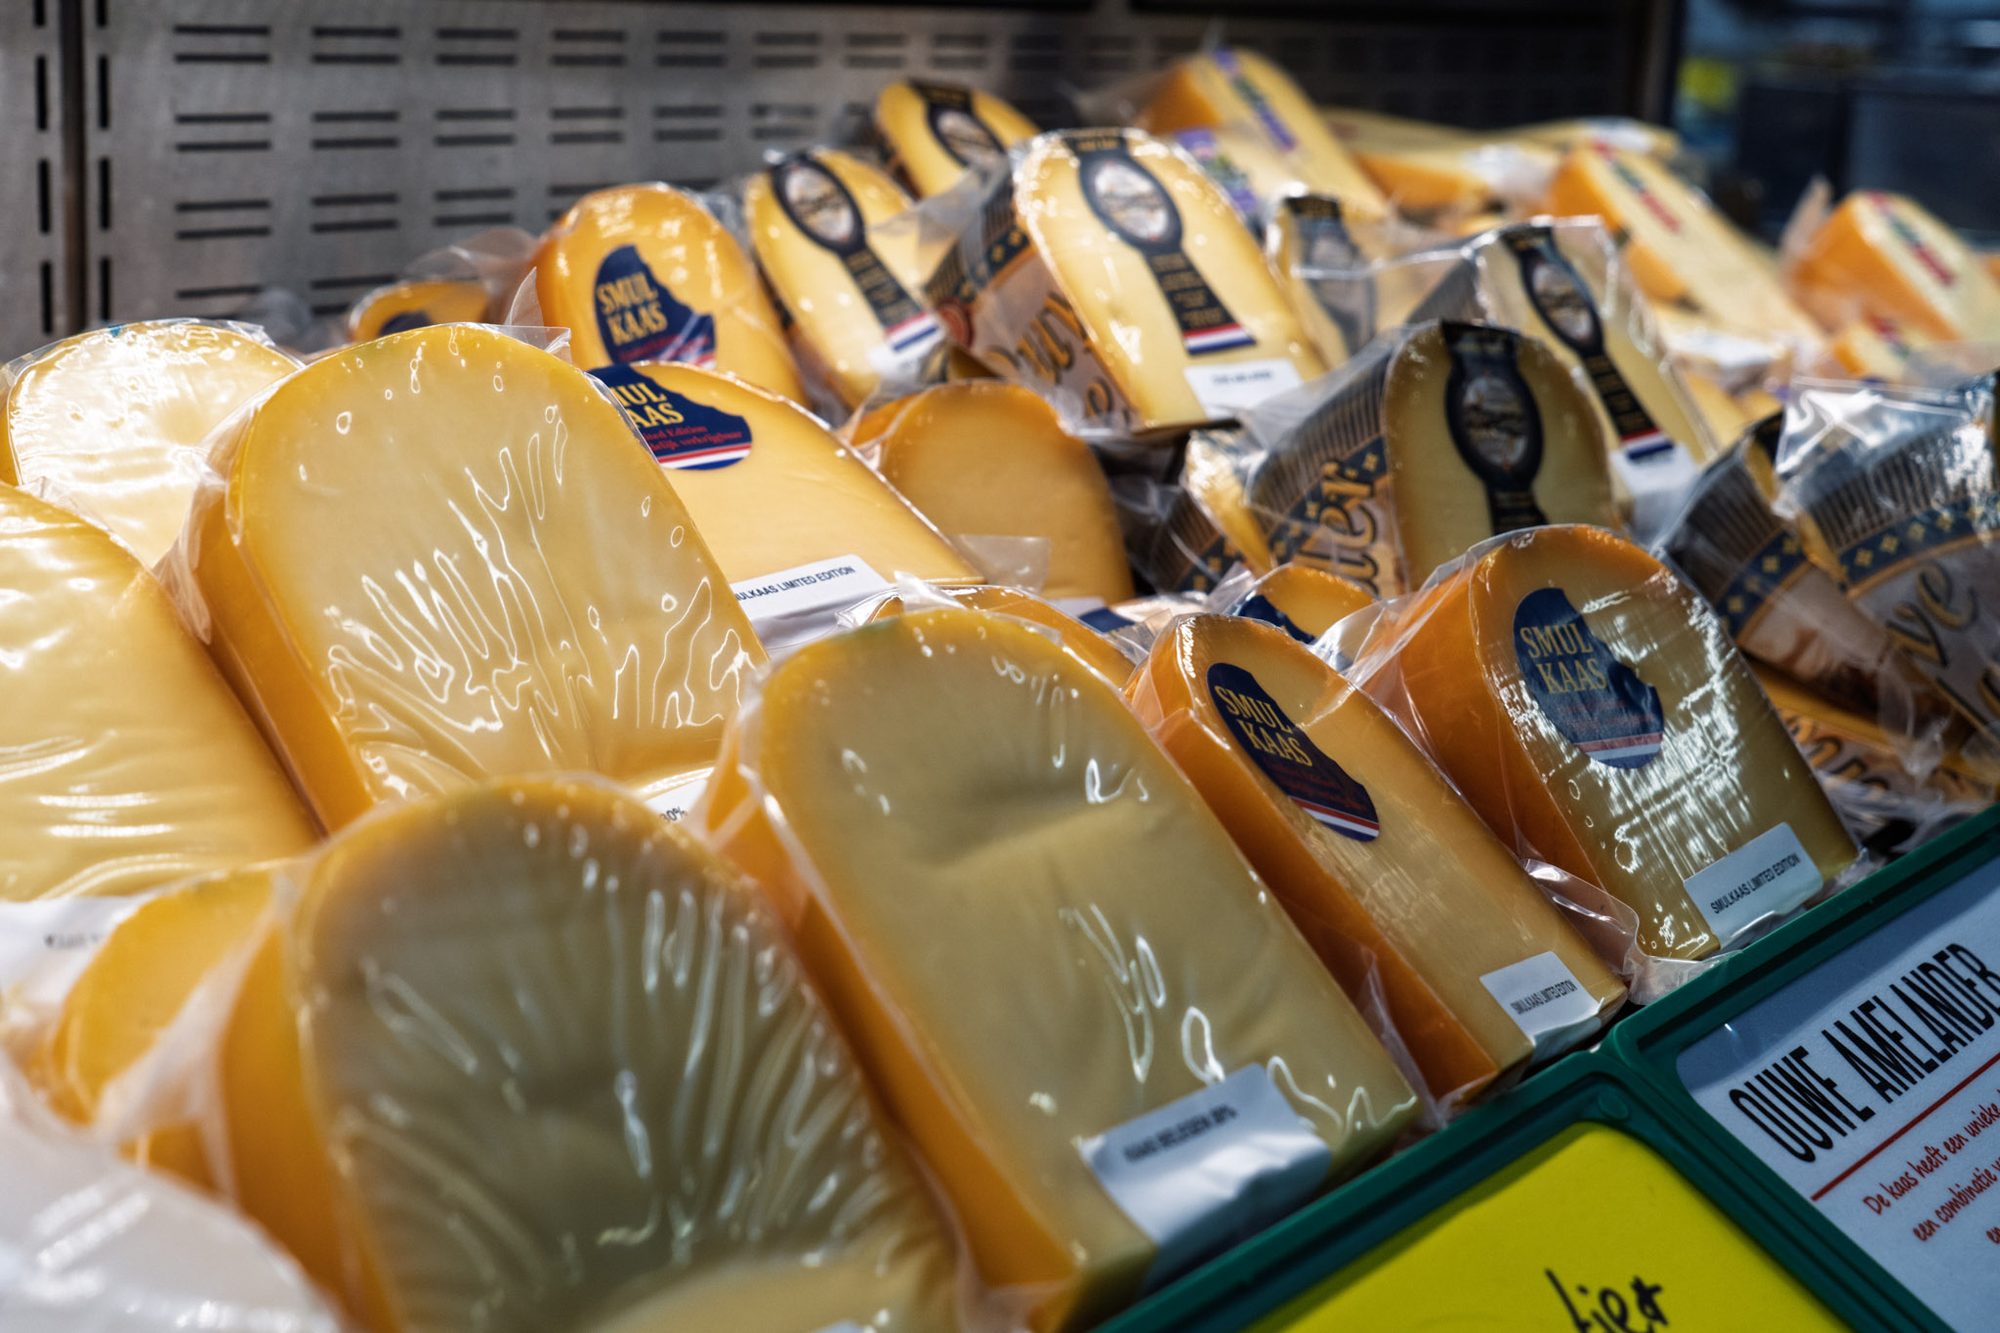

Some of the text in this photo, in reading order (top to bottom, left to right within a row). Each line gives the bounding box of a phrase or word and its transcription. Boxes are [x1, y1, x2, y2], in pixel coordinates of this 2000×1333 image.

[597, 272, 658, 314] SMUL
[607, 302, 668, 345] KAAS
[626, 402, 684, 428] AAS
[735, 565, 856, 601] ULKAAS LIMITED EDITION
[1519, 623, 1594, 659] SMUL
[1536, 658, 1608, 694] KAAS
[1214, 685, 1293, 734] SMUL
[1237, 719, 1312, 767] KAAS
[1710, 853, 1801, 914] SMULKAAS LIMITED EDITION
[1729, 943, 2000, 1163] OUWE AMELANDER
[1862, 1193, 1892, 1216] De
[1879, 1171, 1919, 1200] kaas
[1906, 1144, 1949, 1179] heeft
[1942, 1133, 1970, 1155] een
[1912, 1219, 1941, 1241] een
[1934, 1167, 1998, 1223] combinatie
